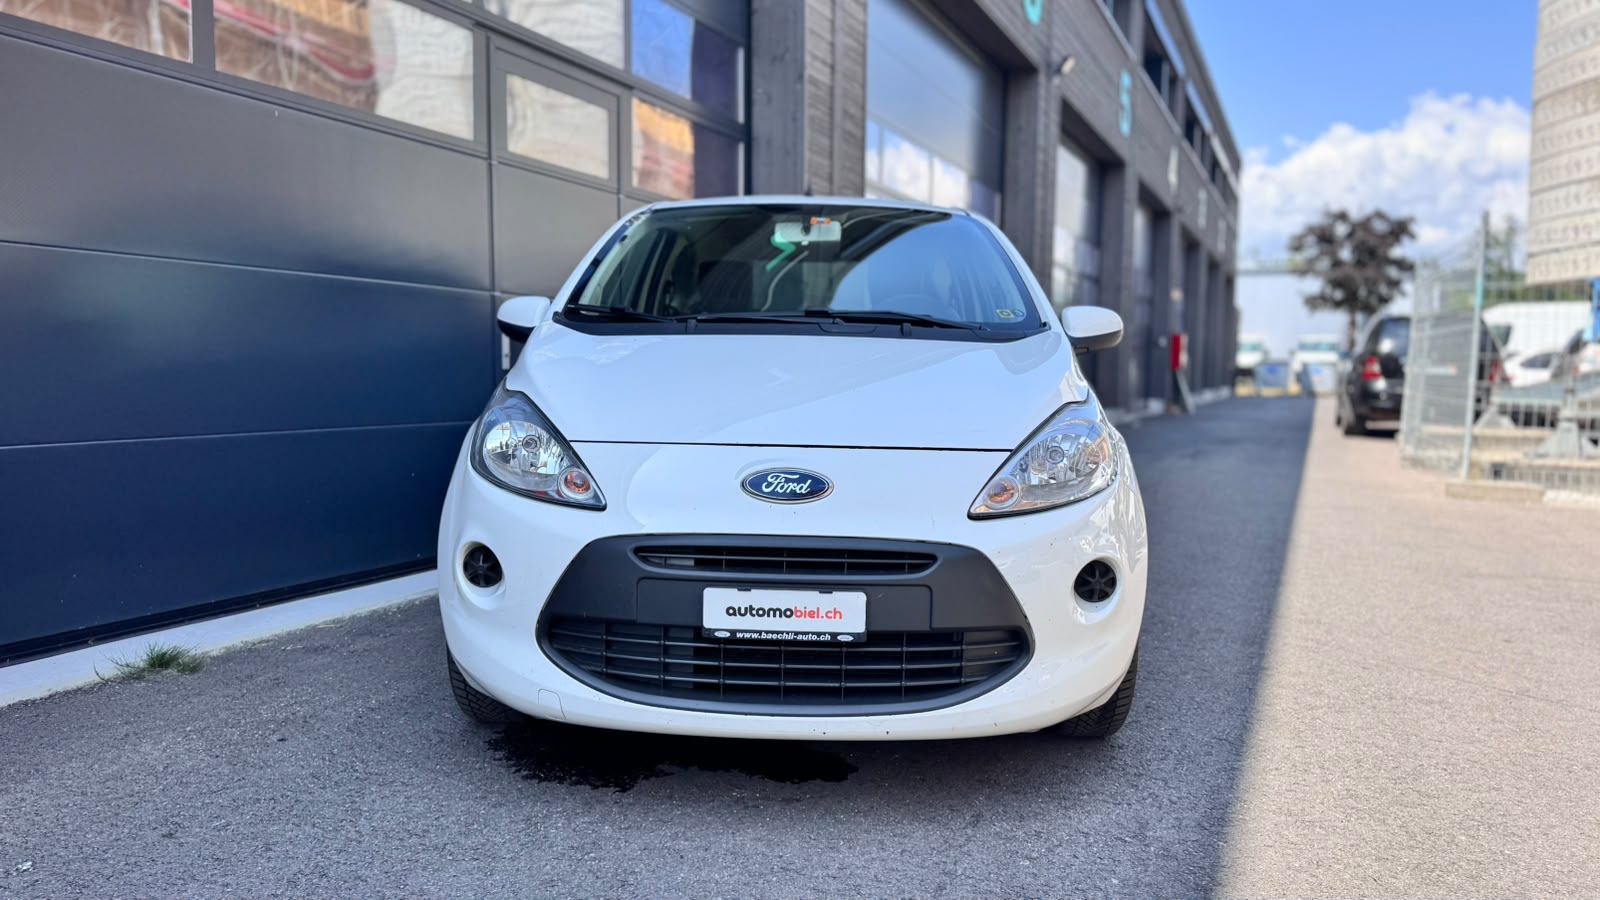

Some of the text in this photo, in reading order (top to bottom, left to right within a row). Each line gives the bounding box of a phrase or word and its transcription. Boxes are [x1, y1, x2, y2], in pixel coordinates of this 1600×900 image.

[762, 473, 812, 493] Ford
[725, 605, 843, 619] automobiel.ch
[736, 631, 831, 641] www.baechli-auto.ch
